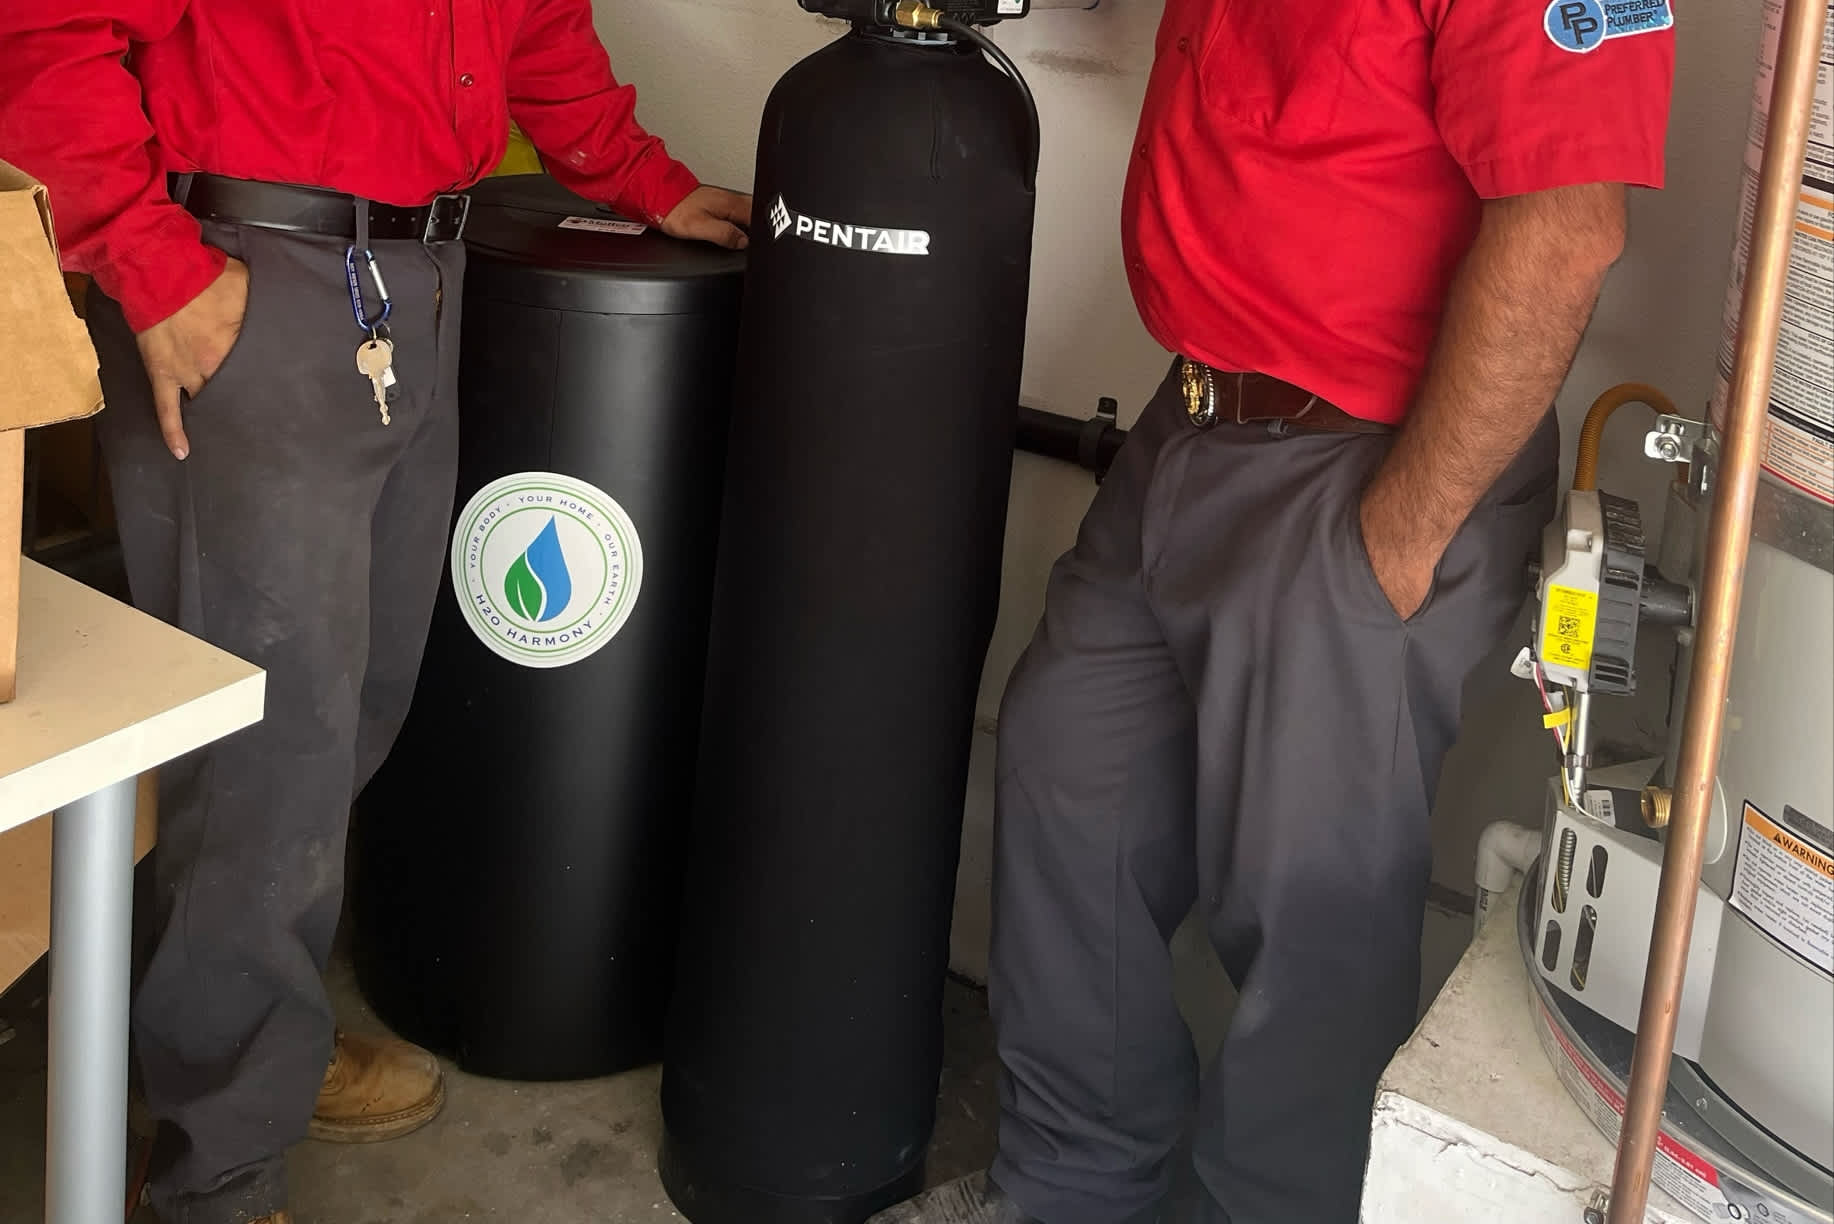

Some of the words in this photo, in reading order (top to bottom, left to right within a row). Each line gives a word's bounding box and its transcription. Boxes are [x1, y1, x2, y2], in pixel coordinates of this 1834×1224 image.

[795, 214, 931, 256] PENTAIR
[518, 495, 553, 504] YOUR
[559, 498, 594, 521] HOME
[479, 506, 503, 532] BODY
[470, 536, 480, 569] YOUR
[604, 533, 618, 558] OUR
[603, 564, 620, 606] EARTH
[476, 594, 501, 627] H2O
[506, 619, 593, 646] HARMONY
[1781, 836, 1834, 875] WARNING
